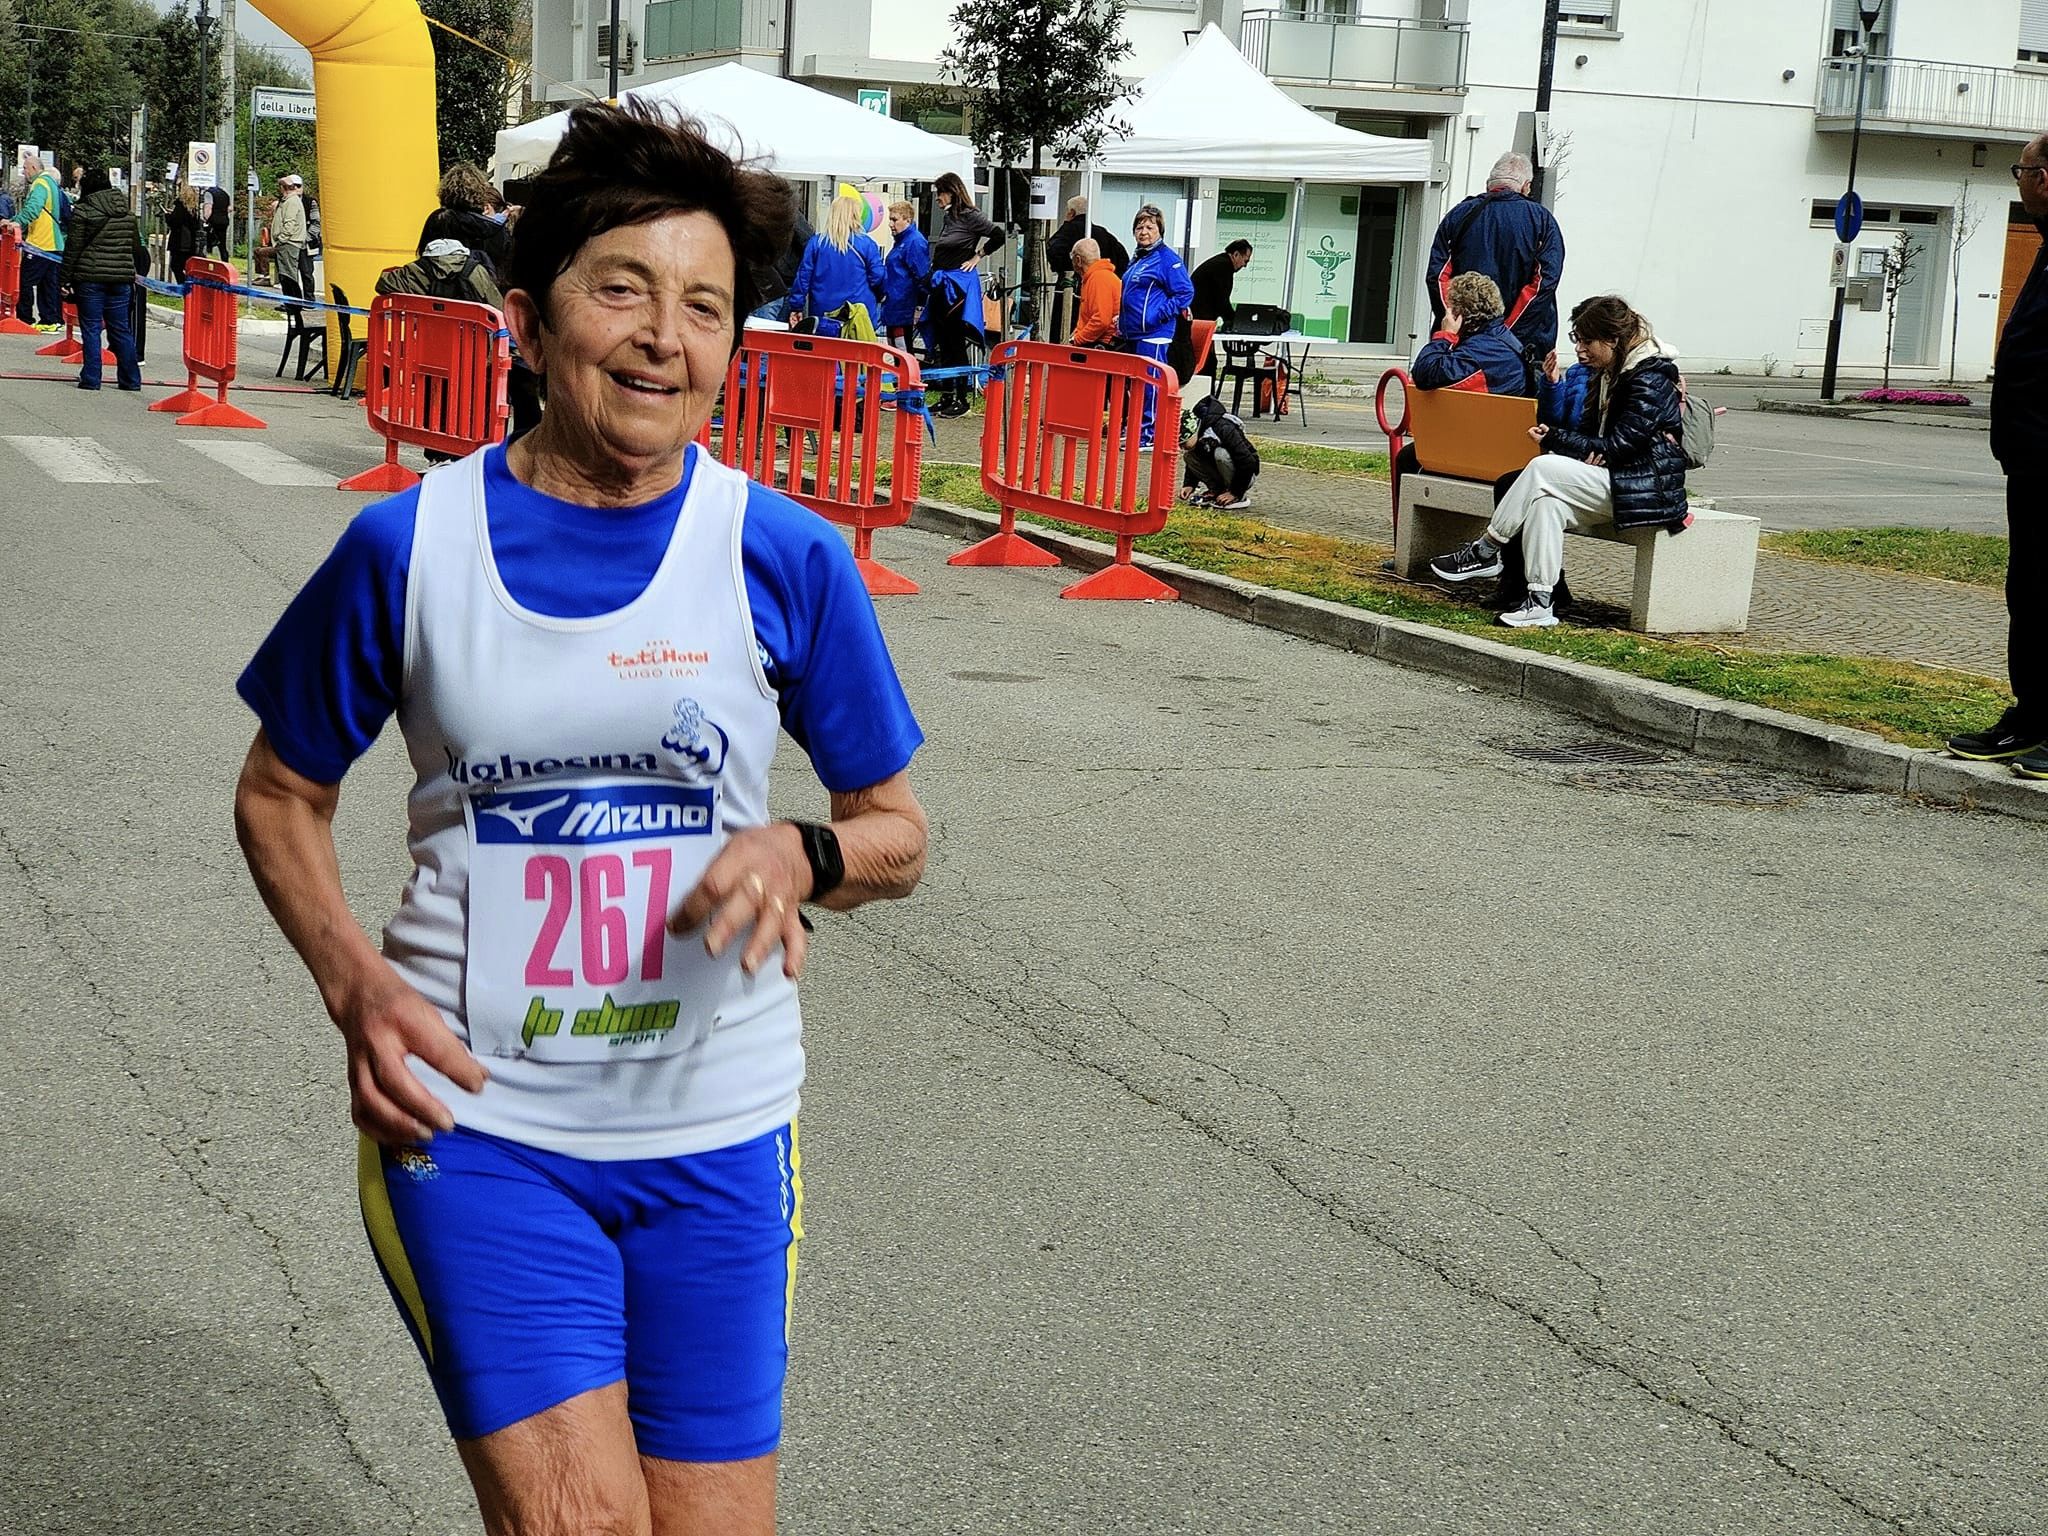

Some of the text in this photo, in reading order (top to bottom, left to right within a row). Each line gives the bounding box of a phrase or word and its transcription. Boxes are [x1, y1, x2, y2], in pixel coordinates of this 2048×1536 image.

[260, 101, 316, 115] della Libert
[1219, 202, 1267, 215] Farmacia
[524, 848, 672, 987] 267
[607, 1030, 668, 1047] SPORT
